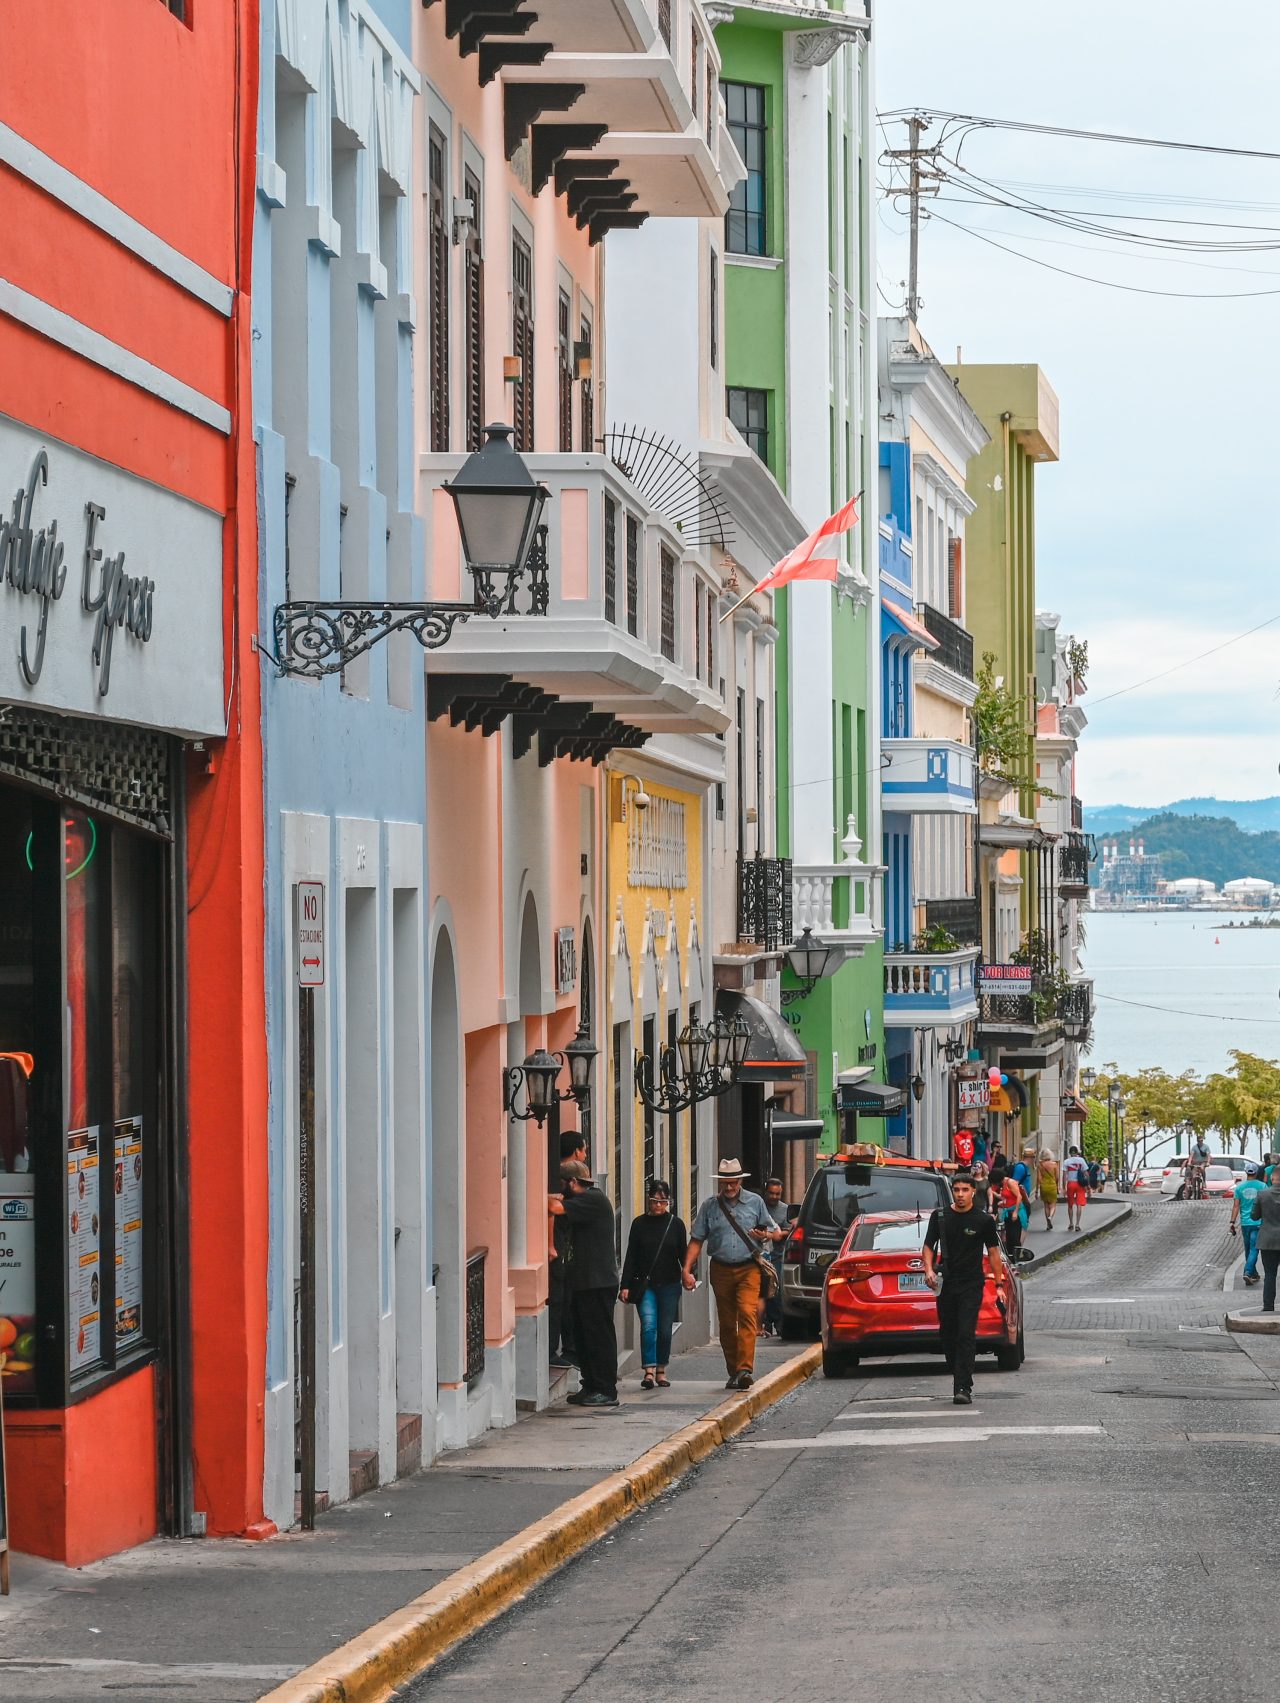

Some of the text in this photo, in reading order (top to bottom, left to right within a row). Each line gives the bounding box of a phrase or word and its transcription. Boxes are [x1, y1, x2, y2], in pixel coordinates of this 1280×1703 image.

[82, 501, 155, 696] Express
[304, 895, 317, 920] NO
[300, 930, 322, 942] ESTACIONE
[985, 966, 1032, 980] FOR LEASE
[968, 1080, 990, 1092] shirts
[960, 1091, 967, 1105] 4
[978, 1089, 990, 1103] 10
